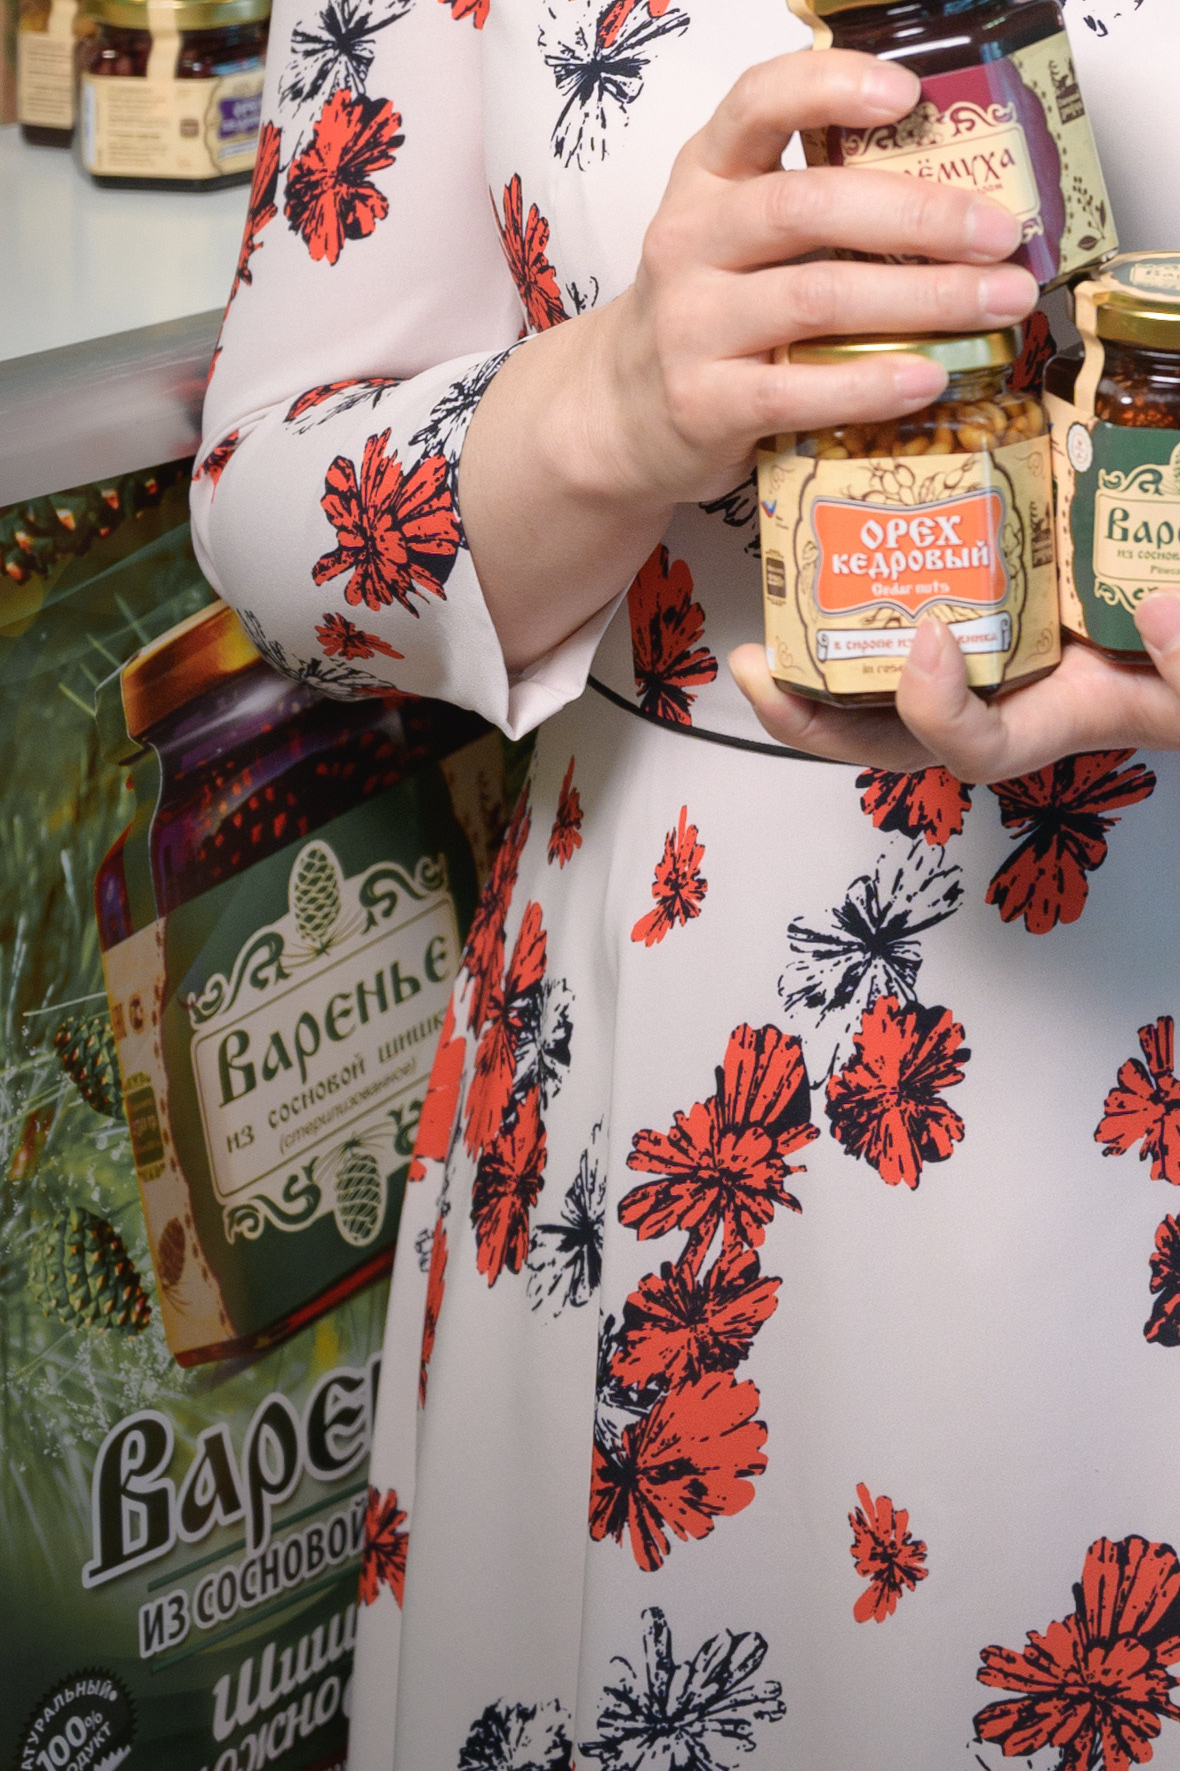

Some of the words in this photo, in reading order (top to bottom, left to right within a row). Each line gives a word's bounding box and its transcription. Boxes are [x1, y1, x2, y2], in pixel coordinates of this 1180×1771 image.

[871, 582, 913, 596] Cedar
[915, 580, 950, 594] nuts
[845, 637, 893, 655] сиропе
[226, 1124, 256, 1154] из
[267, 1054, 367, 1130] сосновой
[83, 1352, 383, 1588] Варе
[139, 1589, 187, 1658] ИЗ
[196, 1495, 369, 1628] СОСНОВОЙ
